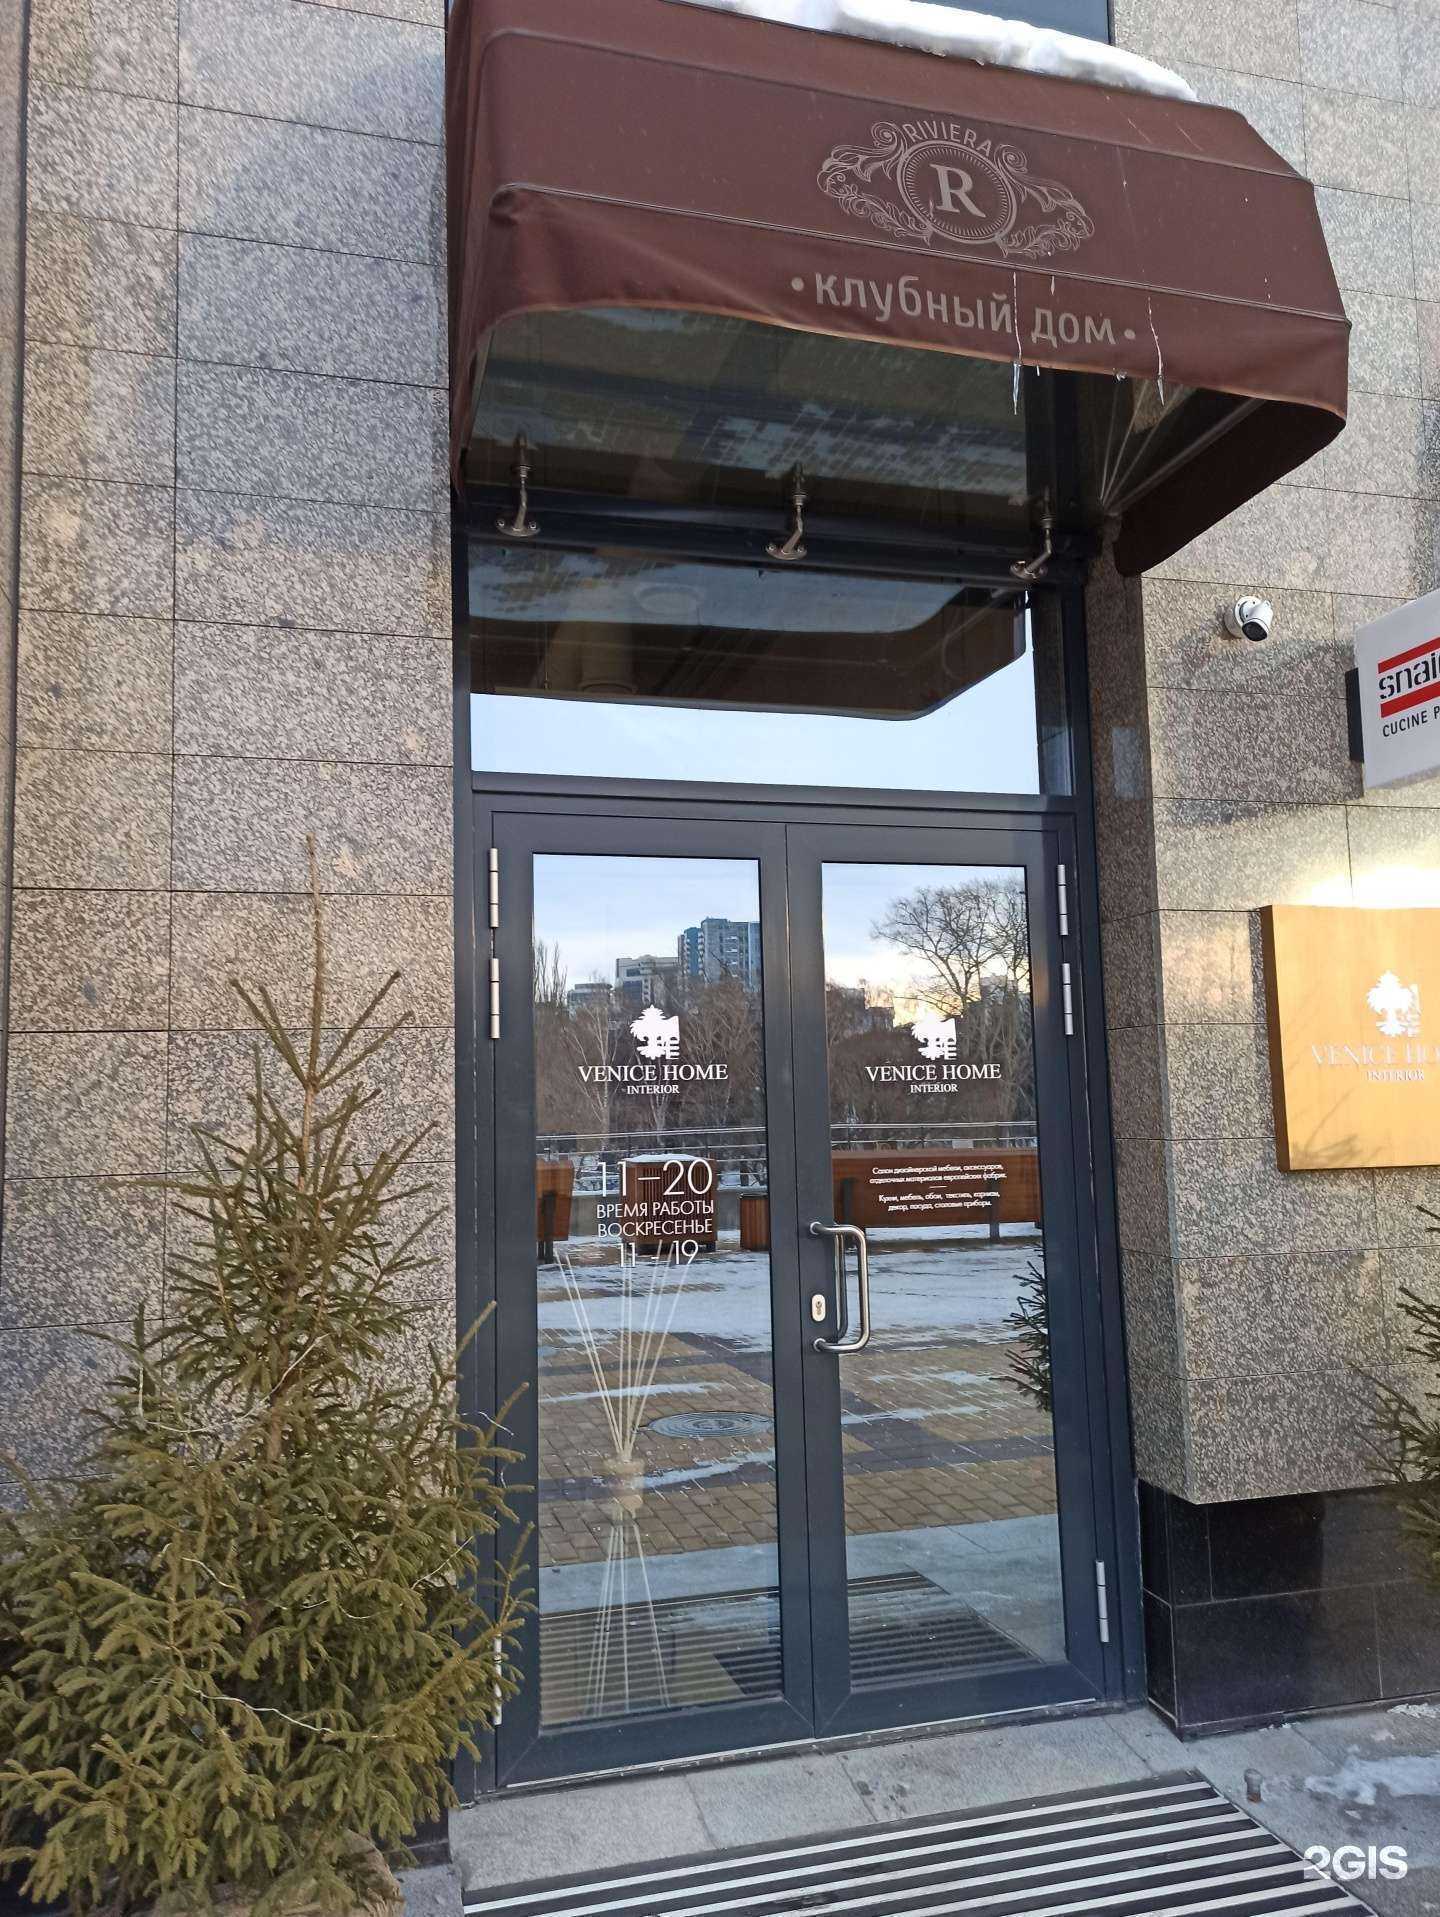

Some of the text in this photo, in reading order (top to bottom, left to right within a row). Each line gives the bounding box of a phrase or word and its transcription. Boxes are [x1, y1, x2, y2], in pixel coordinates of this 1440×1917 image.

[902, 120, 993, 156] RIVIERA
[929, 163, 986, 218] R
[814, 272, 1117, 348] клубный дом
[1378, 652, 1440, 699] snai
[1382, 710, 1428, 737] CUCINE
[578, 1064, 729, 1082] VENICE HOME
[865, 1063, 1002, 1082] VENICE HOME
[1366, 1070, 1425, 1081] INTERIOR
[626, 1084, 680, 1095] INTERIOR
[910, 1083, 958, 1094] INTERIOR
[872, 1167, 893, 1175] Салон
[596, 1199, 714, 1219] ВРЕМЯ РАБОТЫ
[598, 1218, 713, 1238] ВОСКРЕСЕНЬЕ
